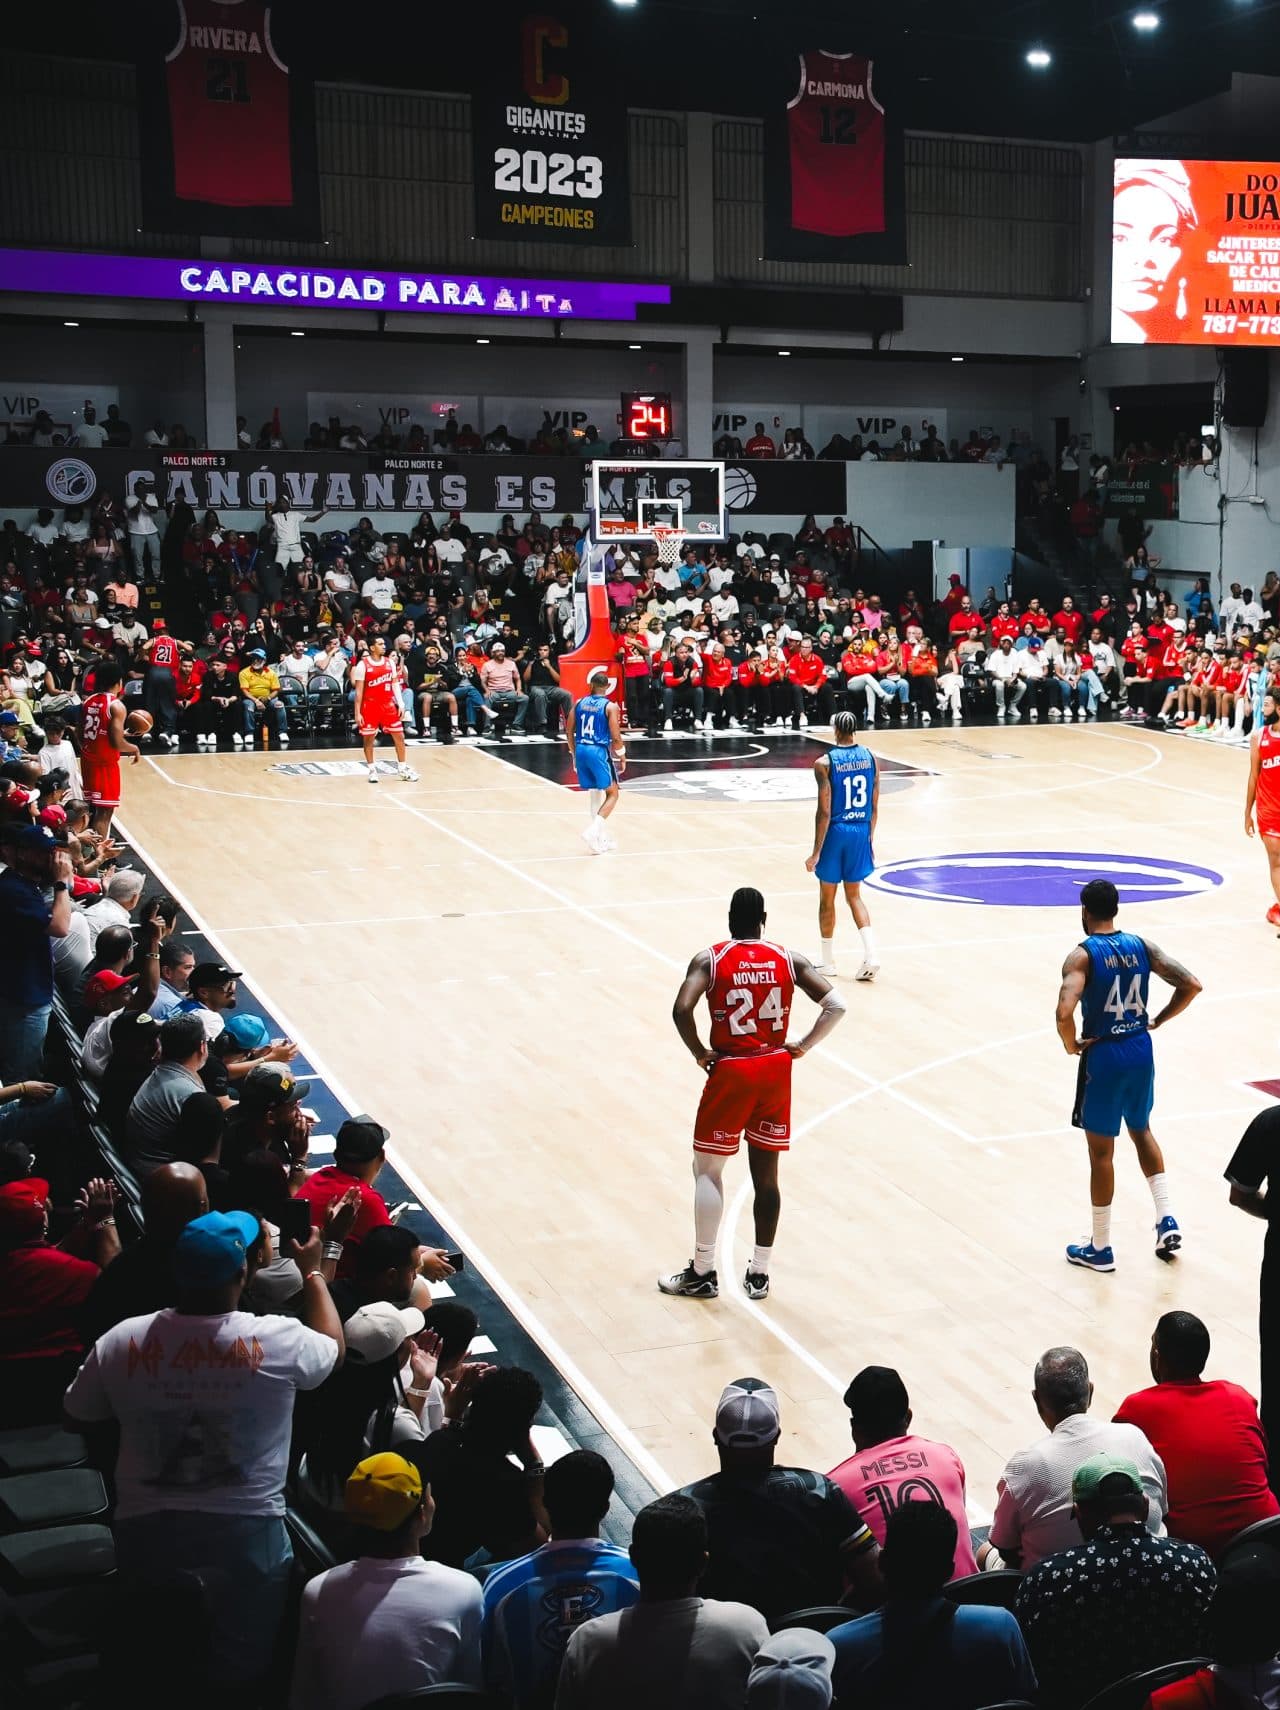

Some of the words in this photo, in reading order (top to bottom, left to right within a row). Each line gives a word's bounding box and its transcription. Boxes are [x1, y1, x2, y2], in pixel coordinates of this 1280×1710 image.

[189, 26, 262, 54] RIVERA
[206, 57, 252, 103] 21
[807, 80, 865, 100] CARMONA
[506, 105, 586, 134] GIGANTES
[819, 105, 857, 145] 12
[512, 127, 580, 140] CAROLINA
[494, 147, 603, 199] 2023
[501, 202, 595, 230] CAMPEONES
[1207, 251, 1255, 265] SACAR
[1259, 252, 1279, 265] TU
[1229, 265, 1247, 278] DE
[180, 266, 385, 303] CAPACIDAD
[400, 279, 485, 308] PARA
[1204, 298, 1267, 315] LLAMA
[3, 397, 40, 416] VIP
[379, 407, 409, 426] VIP
[544, 410, 588, 429] VIP
[631, 404, 665, 437] 24
[713, 414, 748, 432] VIP
[857, 416, 897, 434] VIP
[163, 456, 190, 467] PALCO
[191, 457, 218, 467] NORTE
[219, 457, 226, 467] 3
[384, 459, 411, 469] PALCO
[412, 460, 435, 470] NORTE
[436, 460, 443, 470] 2
[125, 465, 468, 511] CANÓVANAS
[495, 475, 556, 511] ES
[154, 645, 173, 663] 21
[580, 713, 595, 739] 14
[843, 774, 868, 810] 13
[732, 971, 778, 985] NOWELL
[1103, 973, 1146, 1021] 44
[726, 986, 785, 1036] 24
[860, 1451, 929, 1481] MESSI
